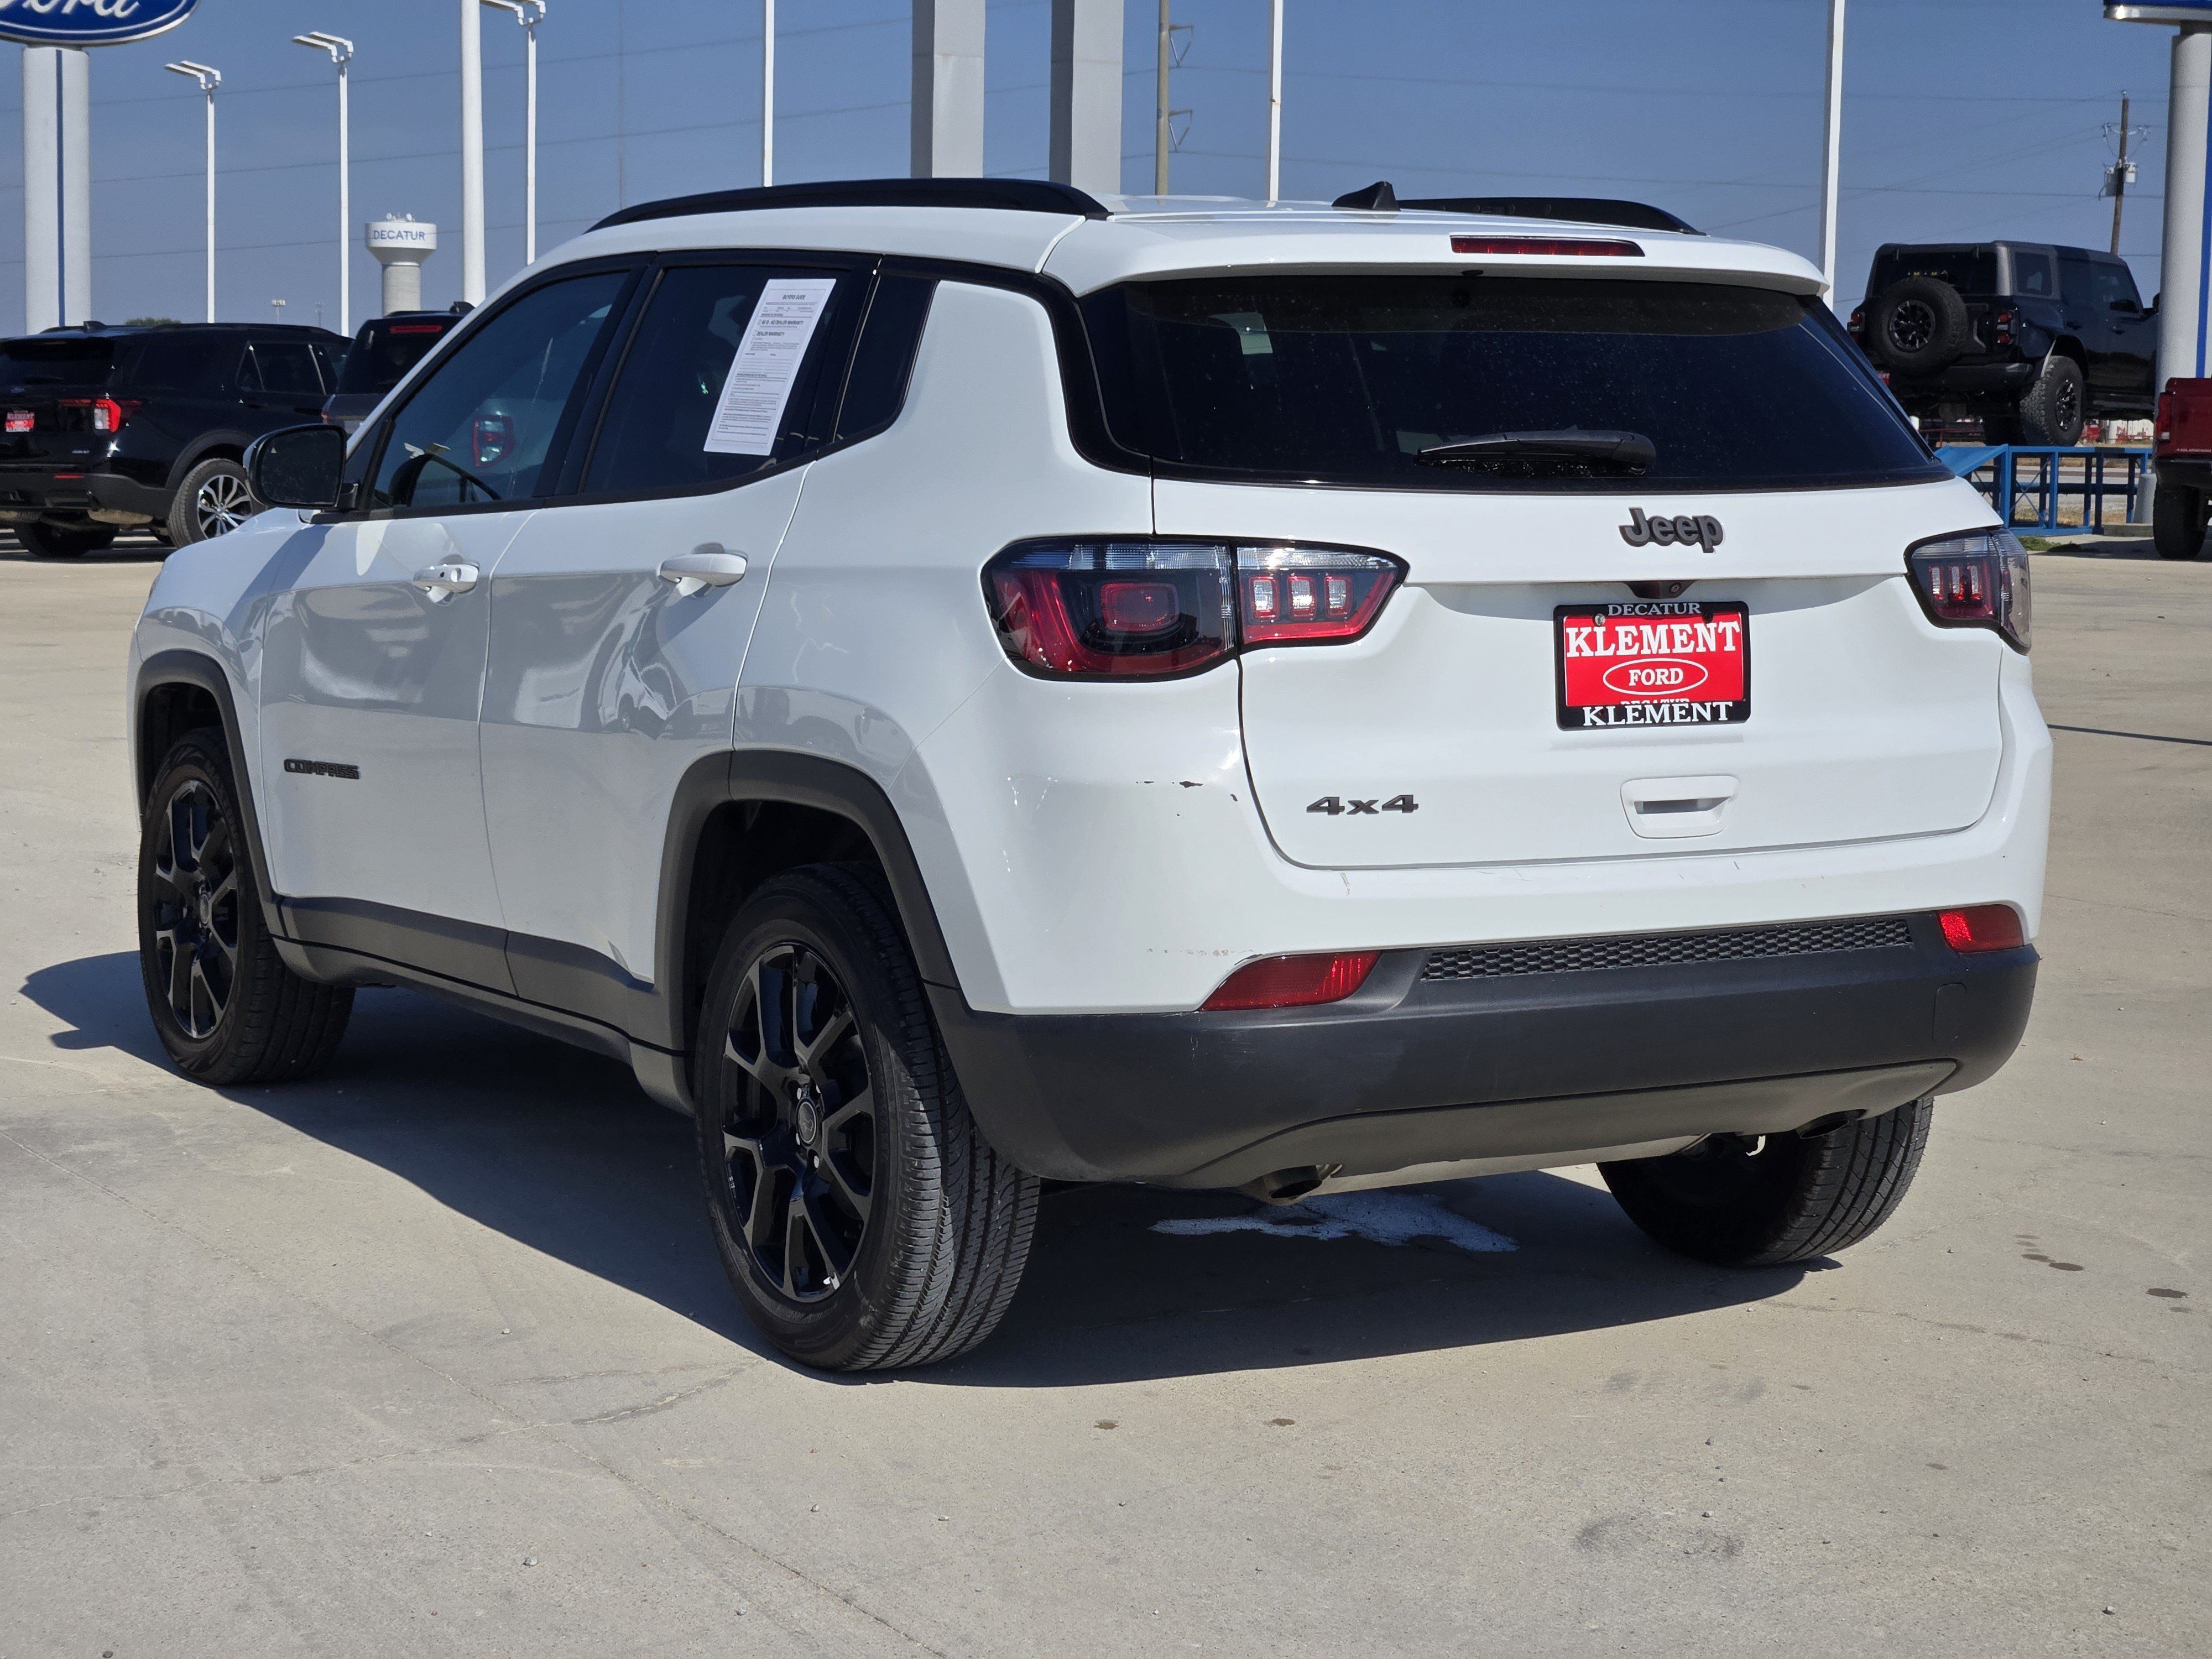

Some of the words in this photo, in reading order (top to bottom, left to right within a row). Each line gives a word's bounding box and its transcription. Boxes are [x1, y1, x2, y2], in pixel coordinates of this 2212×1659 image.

[373, 230, 425, 241] DECATUR
[1619, 507, 1724, 554] Jeep
[1608, 603, 1702, 616] DECATUR
[1566, 620, 1740, 658] KLEMENT
[1629, 667, 1684, 686] FORD
[1583, 701, 1733, 726] KLEMENT
[284, 758, 360, 780] COMPASS
[1306, 794, 1419, 816] 4x4
